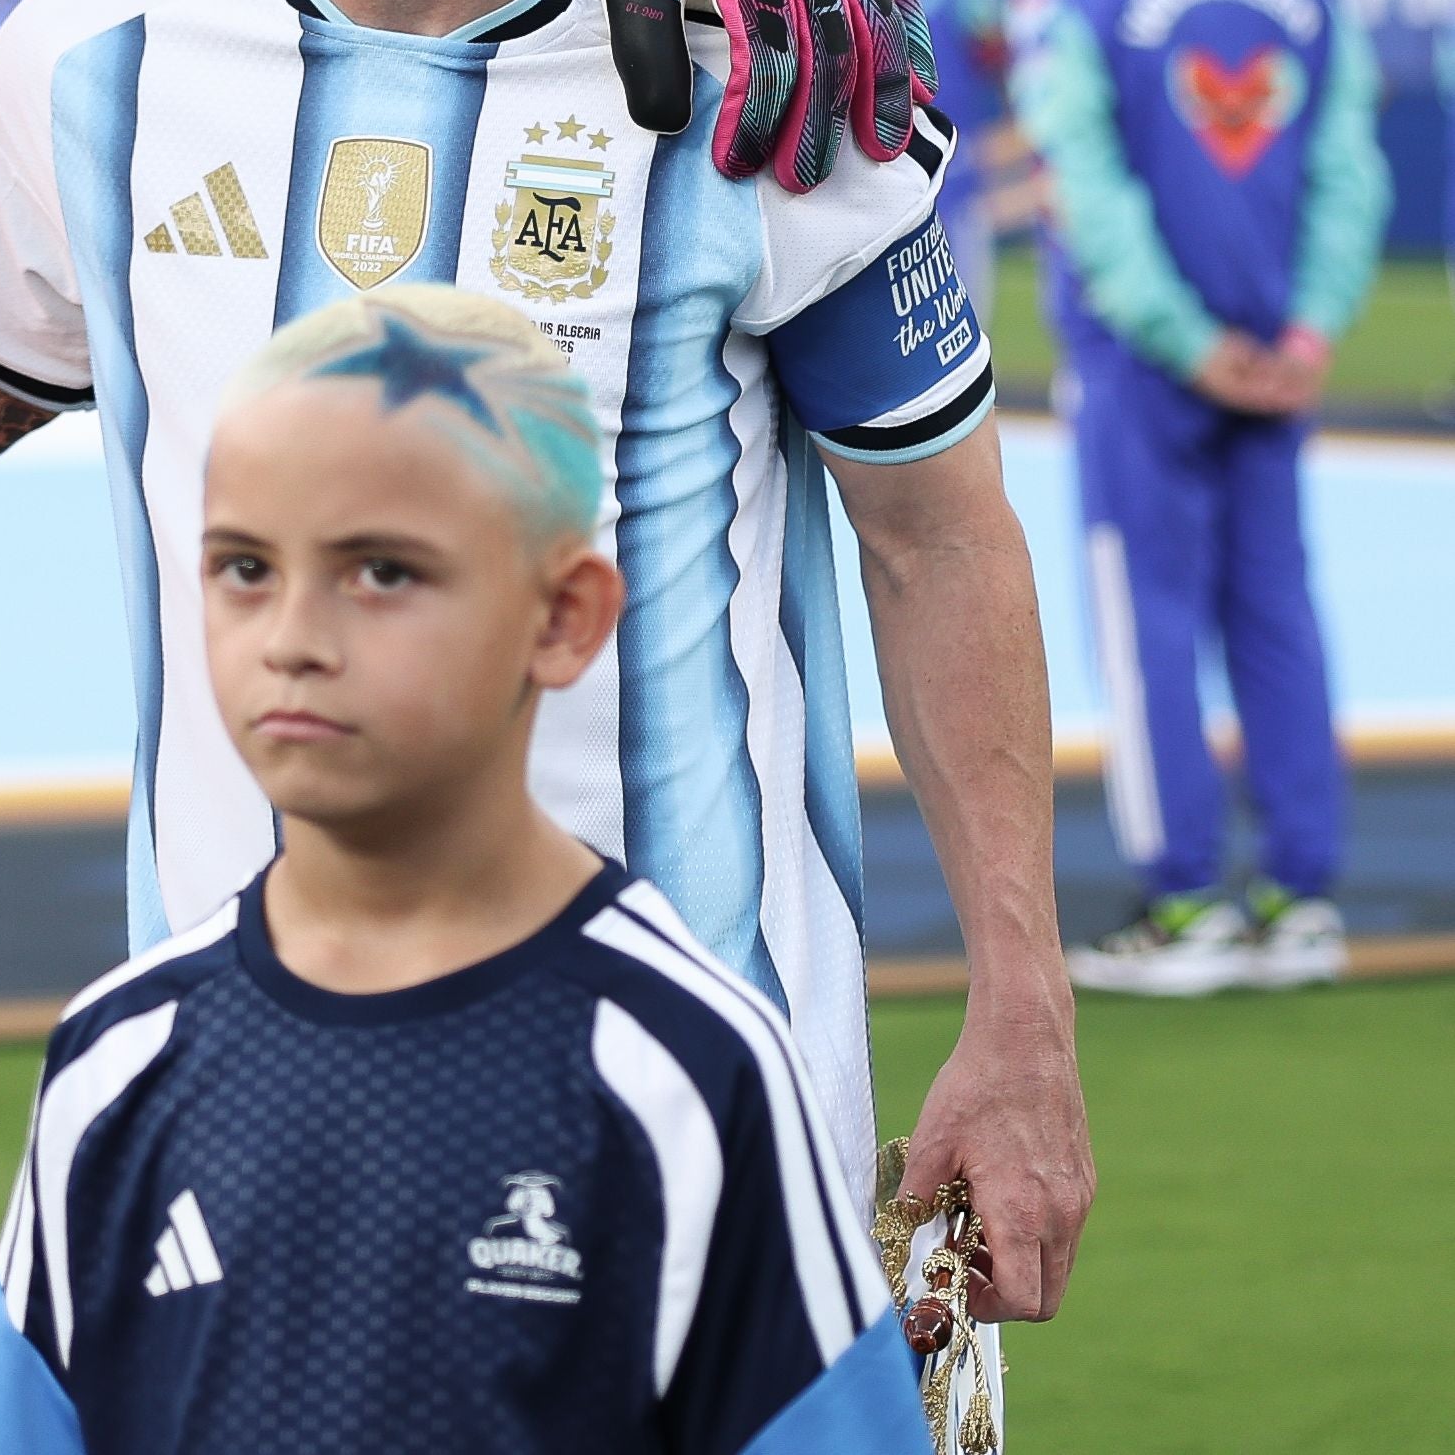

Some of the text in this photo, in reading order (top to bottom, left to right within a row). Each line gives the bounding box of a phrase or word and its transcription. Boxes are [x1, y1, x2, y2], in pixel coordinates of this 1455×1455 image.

[514, 192, 587, 263] AFA
[346, 233, 395, 254] FIFA
[333, 252, 405, 263] WORLD CHAMPIONS
[352, 260, 382, 273] 2022
[556, 323, 601, 341] ALGERIA
[893, 316, 936, 357] the
[941, 326, 969, 359] FIFA
[469, 1236, 581, 1278] QUAKER
